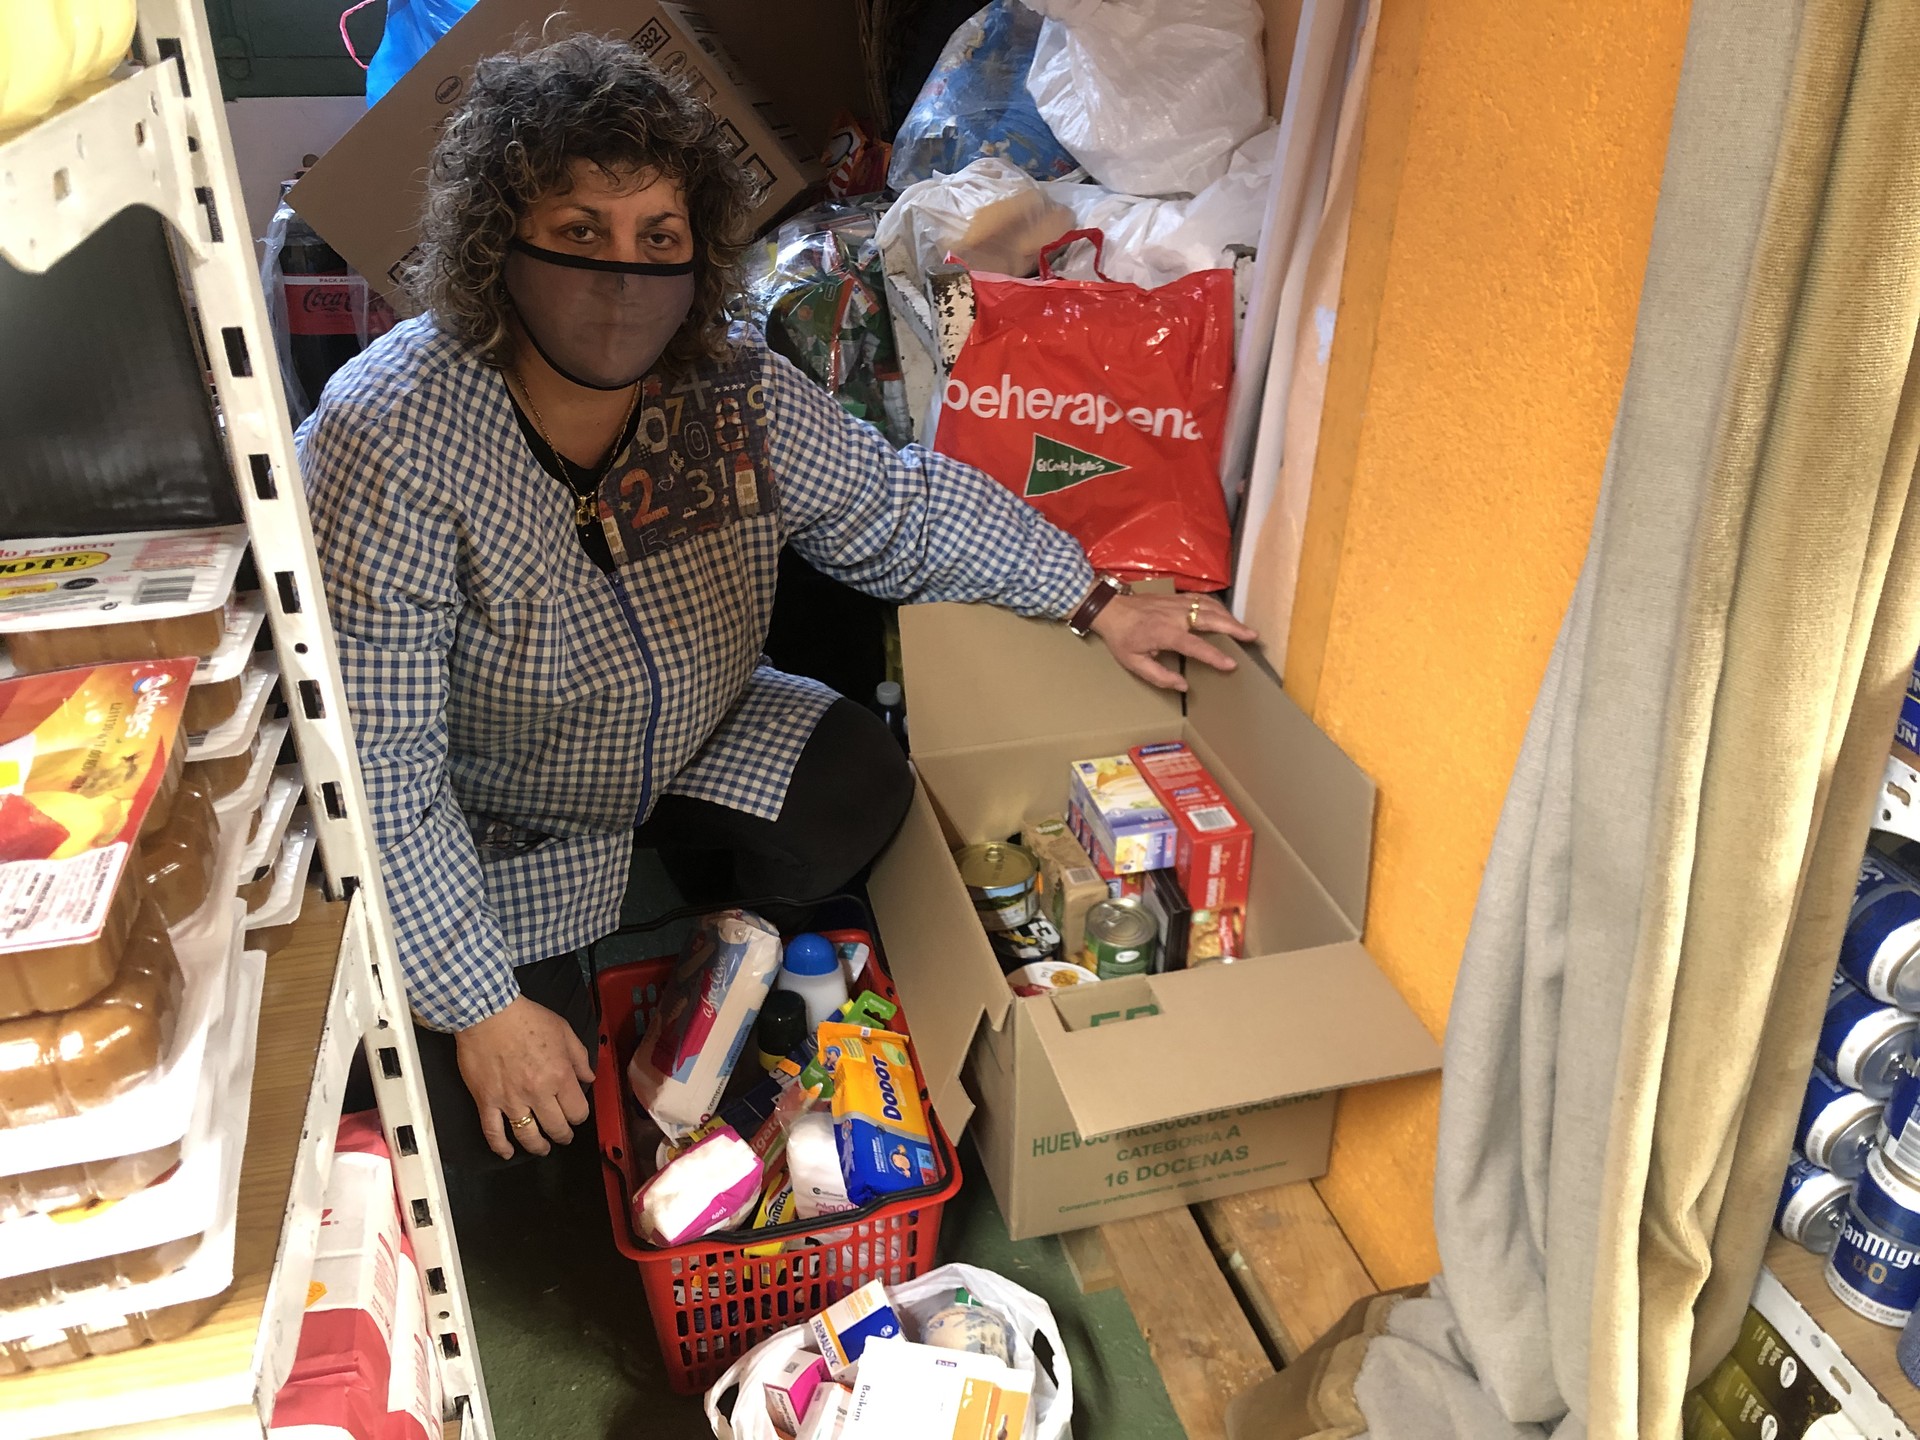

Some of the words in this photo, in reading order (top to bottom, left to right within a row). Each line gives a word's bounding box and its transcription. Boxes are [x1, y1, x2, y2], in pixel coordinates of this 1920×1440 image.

[620, 468, 670, 529] 2
[873, 1055, 903, 1121] DODOT
[1226, 1124, 1240, 1139] A
[1105, 1170, 1129, 1187] 16
[1136, 1146, 1249, 1182] DOCENAS
